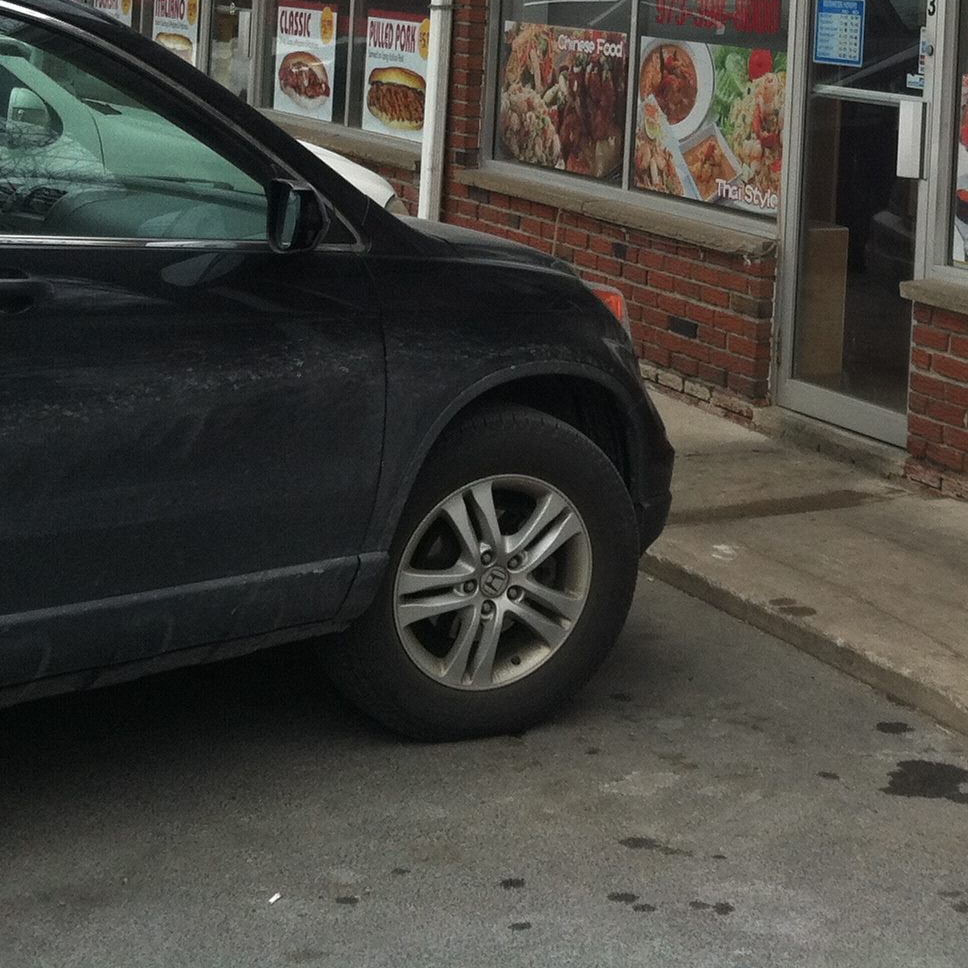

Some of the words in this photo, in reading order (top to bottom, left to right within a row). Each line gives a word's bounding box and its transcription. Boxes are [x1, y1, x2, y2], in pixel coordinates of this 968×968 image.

[280, 10, 312, 38] CLASSIC
[369, 20, 393, 49] PULLED
[394, 23, 417, 54] PORK
[557, 34, 596, 55] Chinese
[597, 38, 624, 58] Food
[715, 178, 743, 200] Thai
[744, 182, 779, 209] Style
